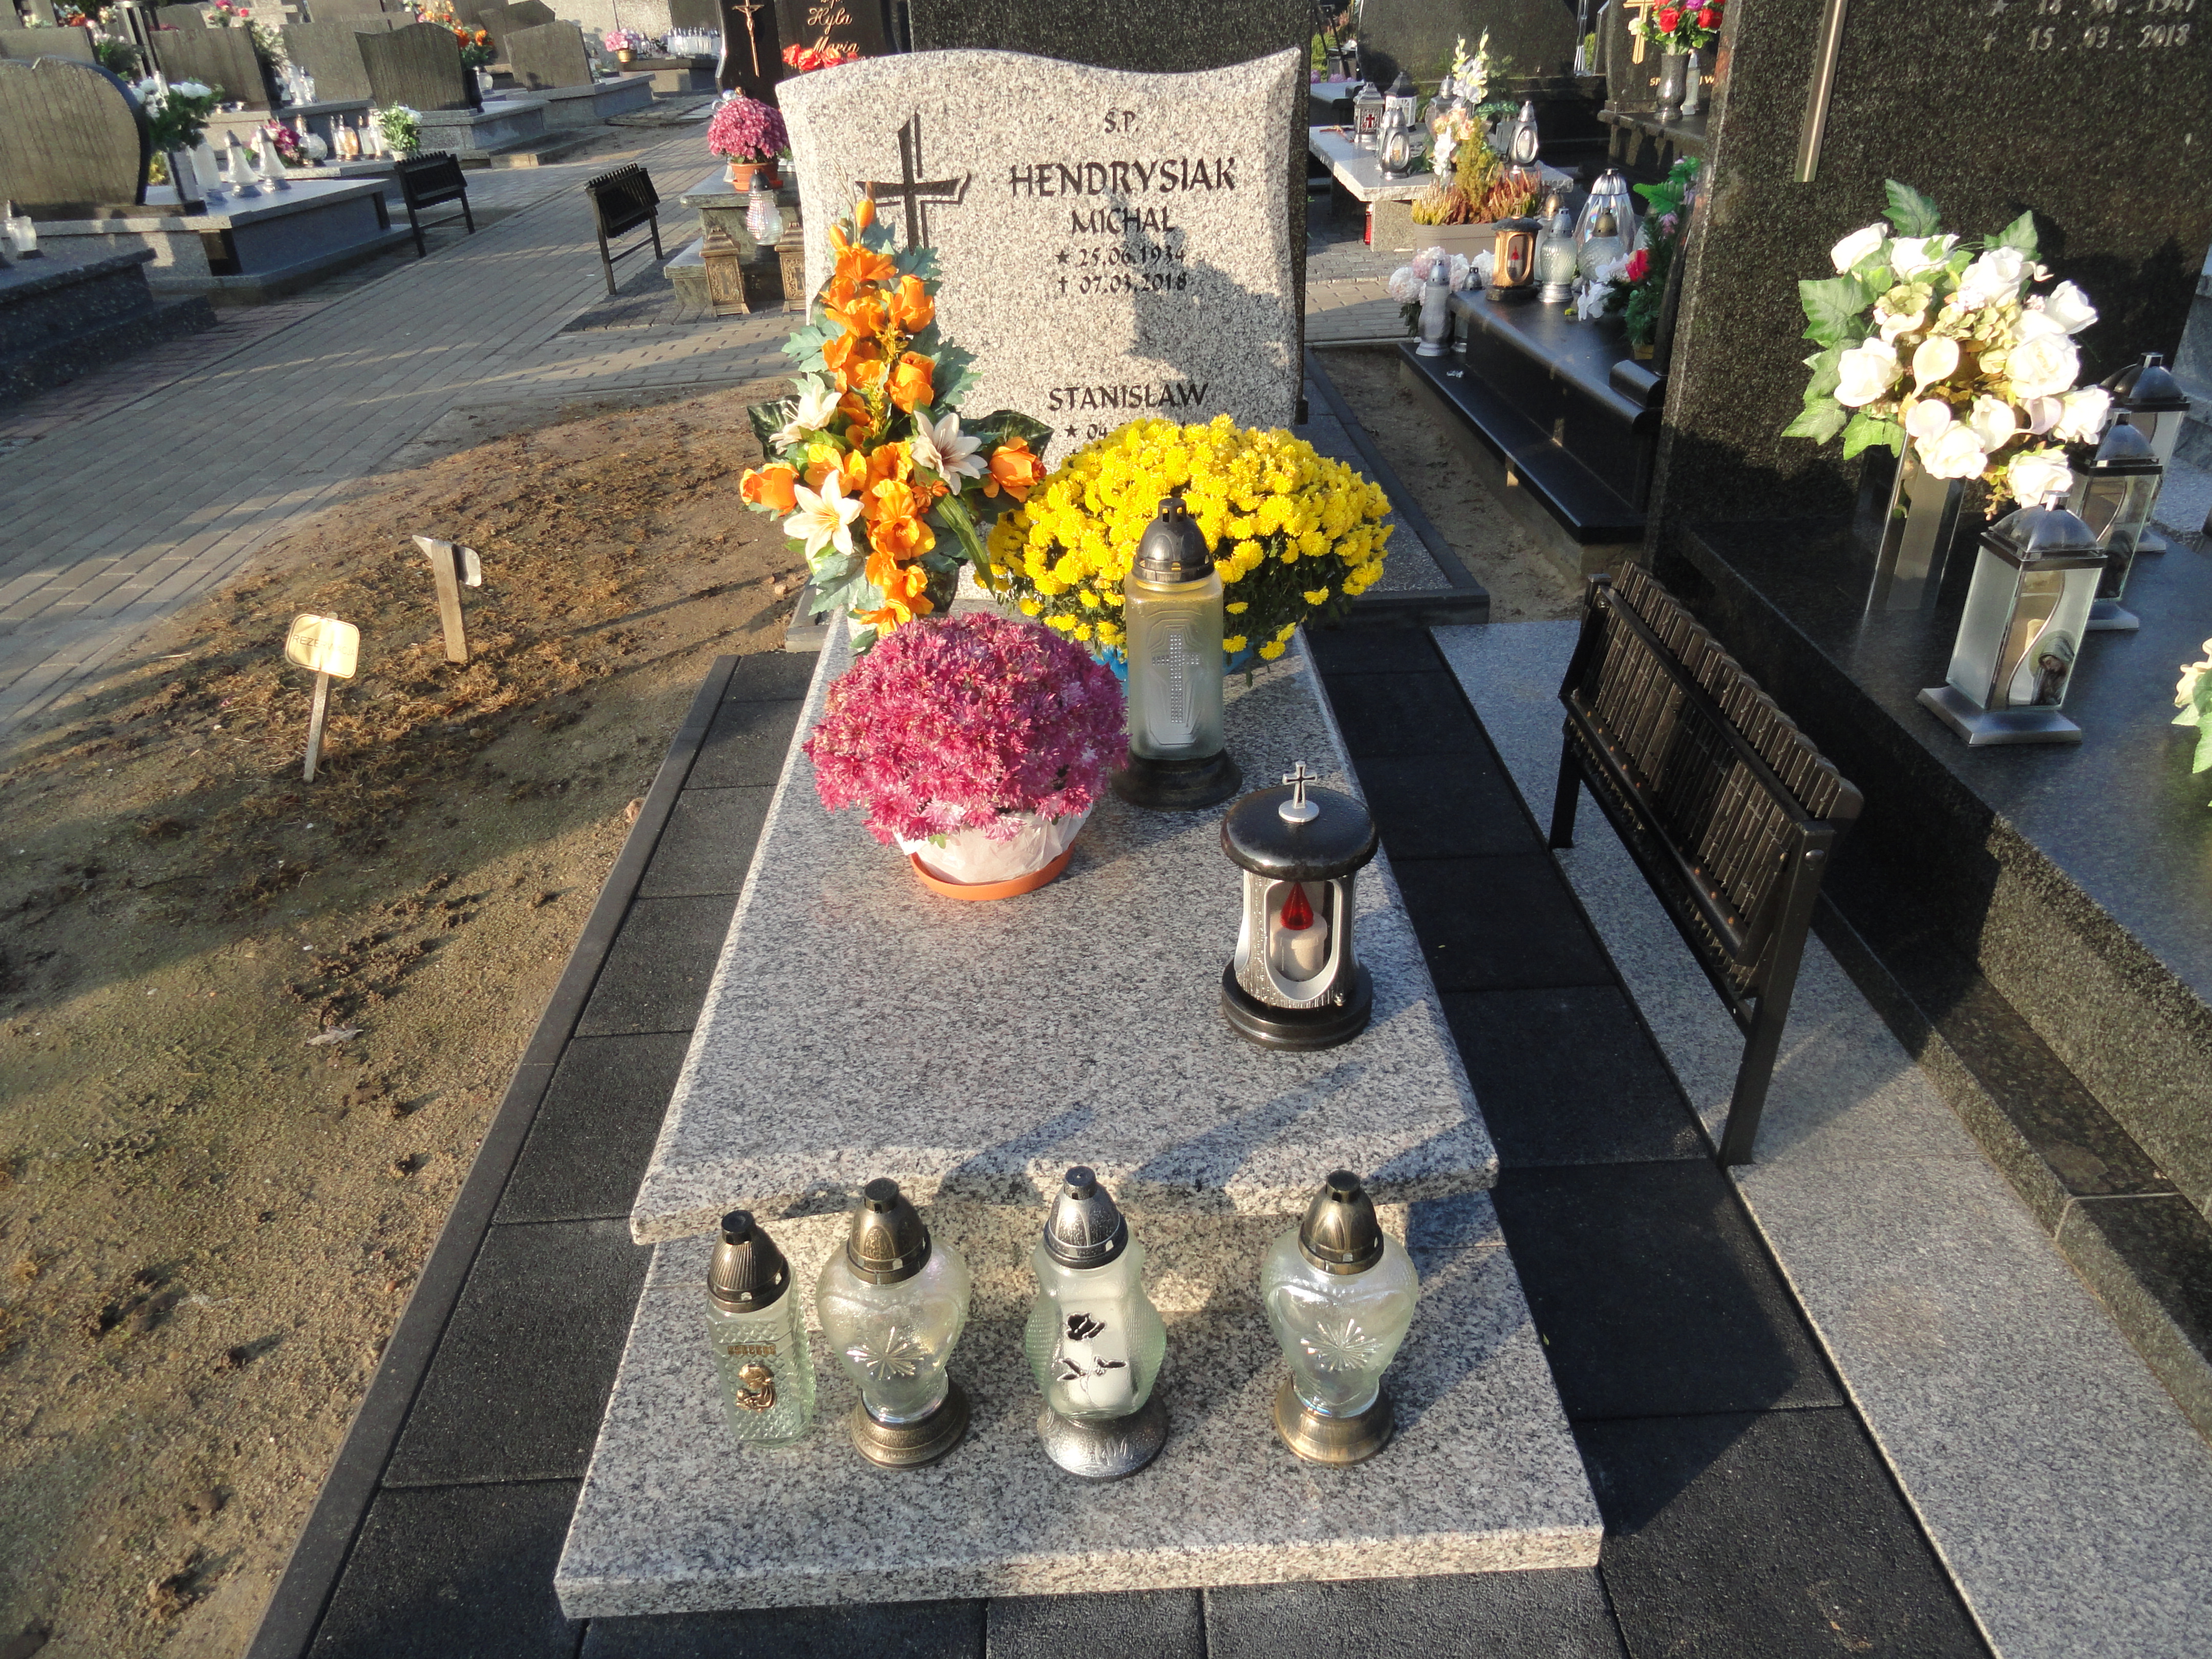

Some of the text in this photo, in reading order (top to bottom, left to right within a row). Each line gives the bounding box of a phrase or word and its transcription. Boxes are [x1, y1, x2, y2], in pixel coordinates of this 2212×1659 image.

[2138, 24, 2190, 48] 2018
[1009, 157, 1236, 197] HENDRYSIAK
[1071, 206, 1176, 236] MICHAŁ
[1079, 244, 1187, 267] 25.06.1934
[1079, 271, 1187, 294] 07.03.2018
[1048, 382, 1209, 412] STANISŁAW
[292, 634, 355, 657] REZERWCJA
